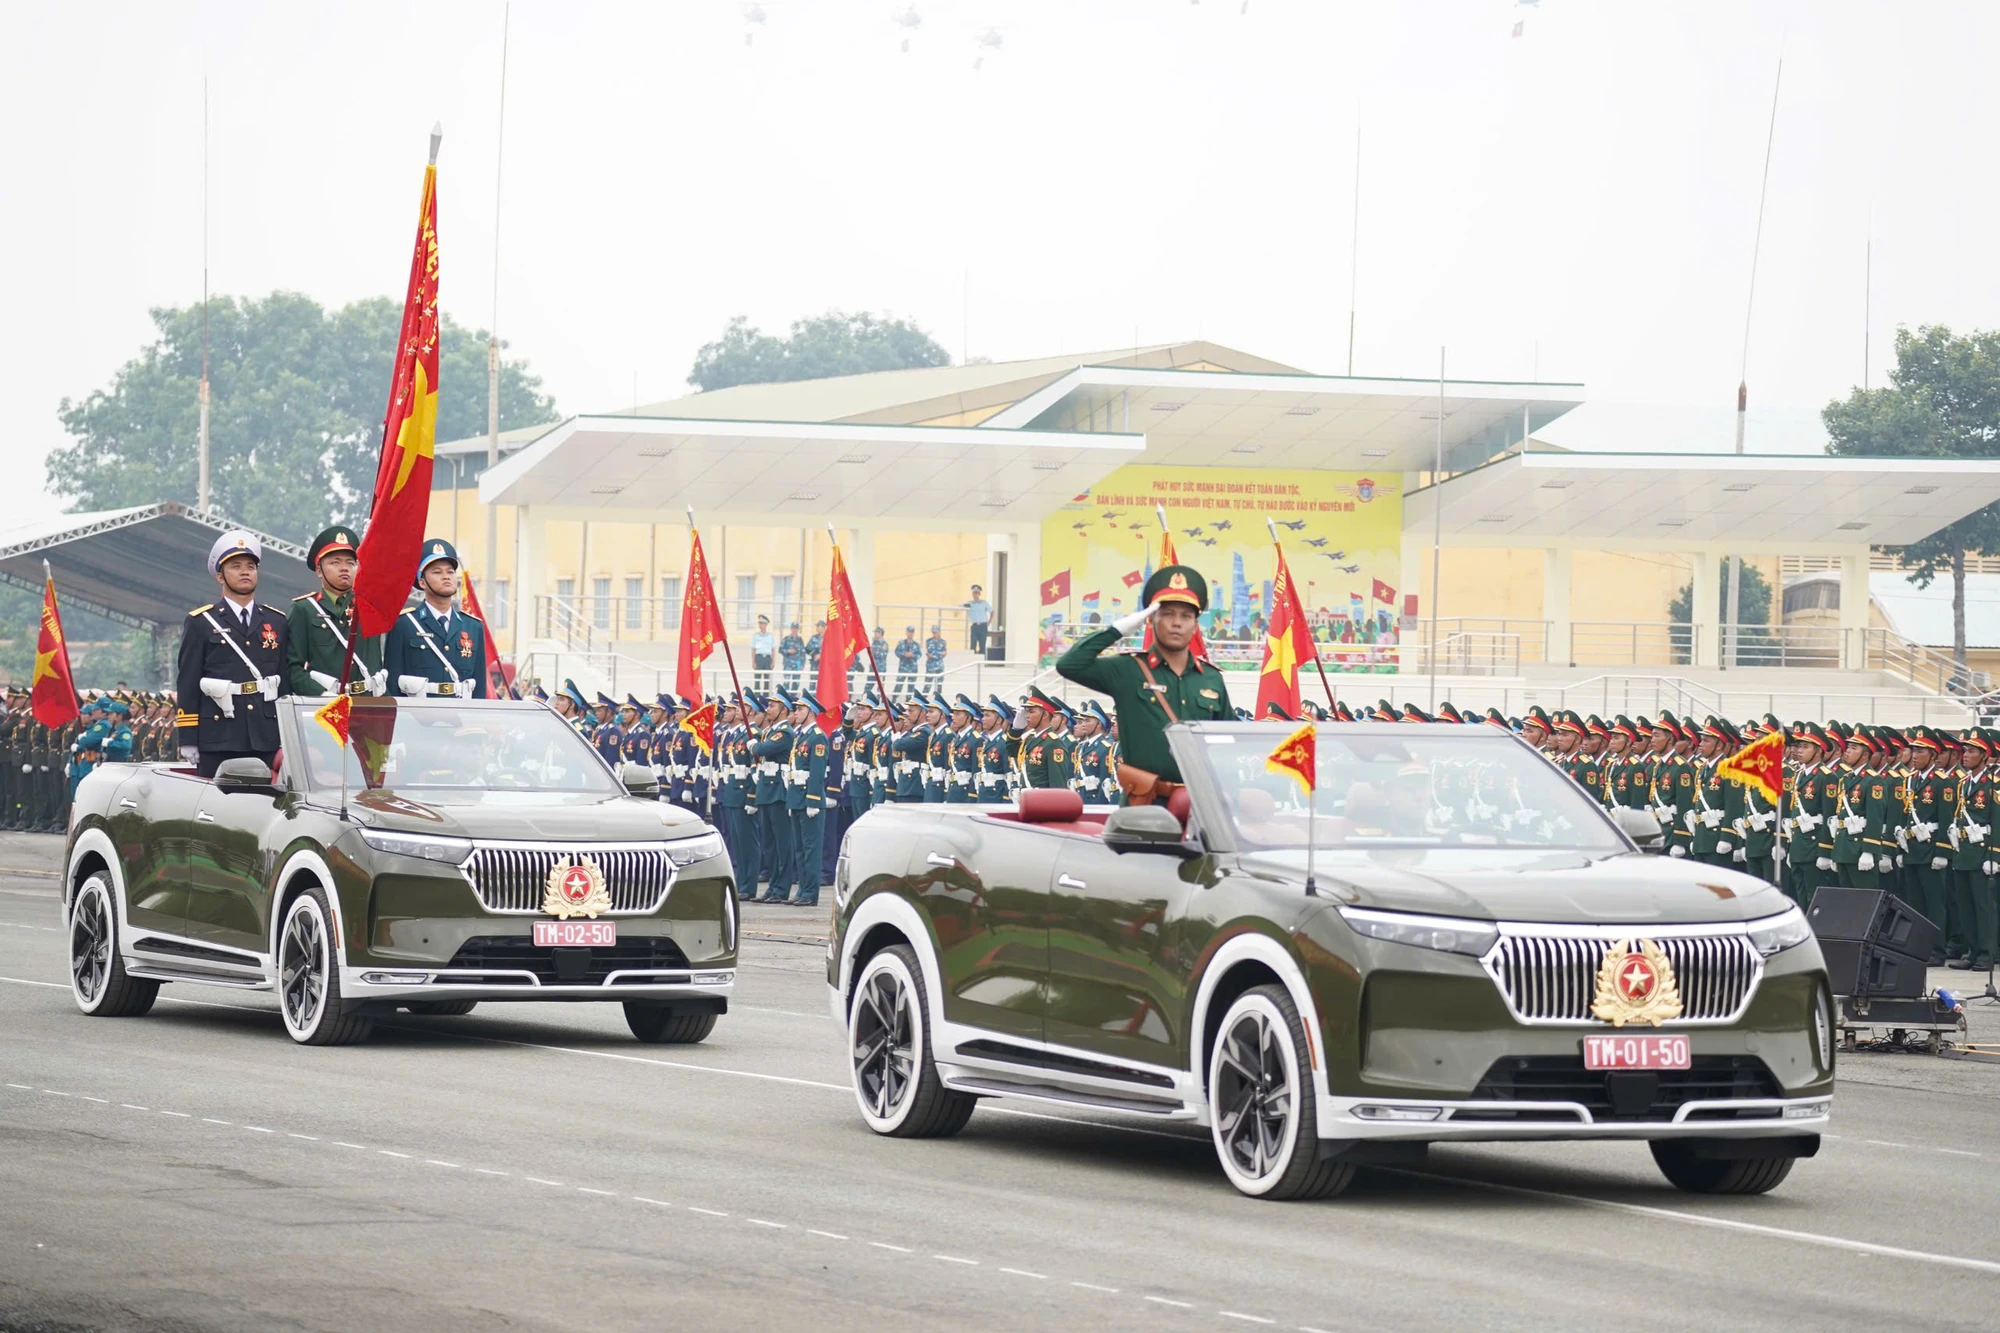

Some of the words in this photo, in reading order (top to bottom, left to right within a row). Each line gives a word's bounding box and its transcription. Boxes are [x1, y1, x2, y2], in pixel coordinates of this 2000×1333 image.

[1152, 479, 1168, 491] PHÁT
[1169, 481, 1181, 491] HUY
[1183, 480, 1194, 492] SỨC
[1245, 481, 1255, 494] KẾT
[1135, 494, 1147, 506] SỨC
[1168, 497, 1180, 507] CON
[1202, 496, 1214, 509] VIỆT
[536, 924, 613, 944] TM-02-50
[1588, 1039, 1687, 1067] TM-01-50
